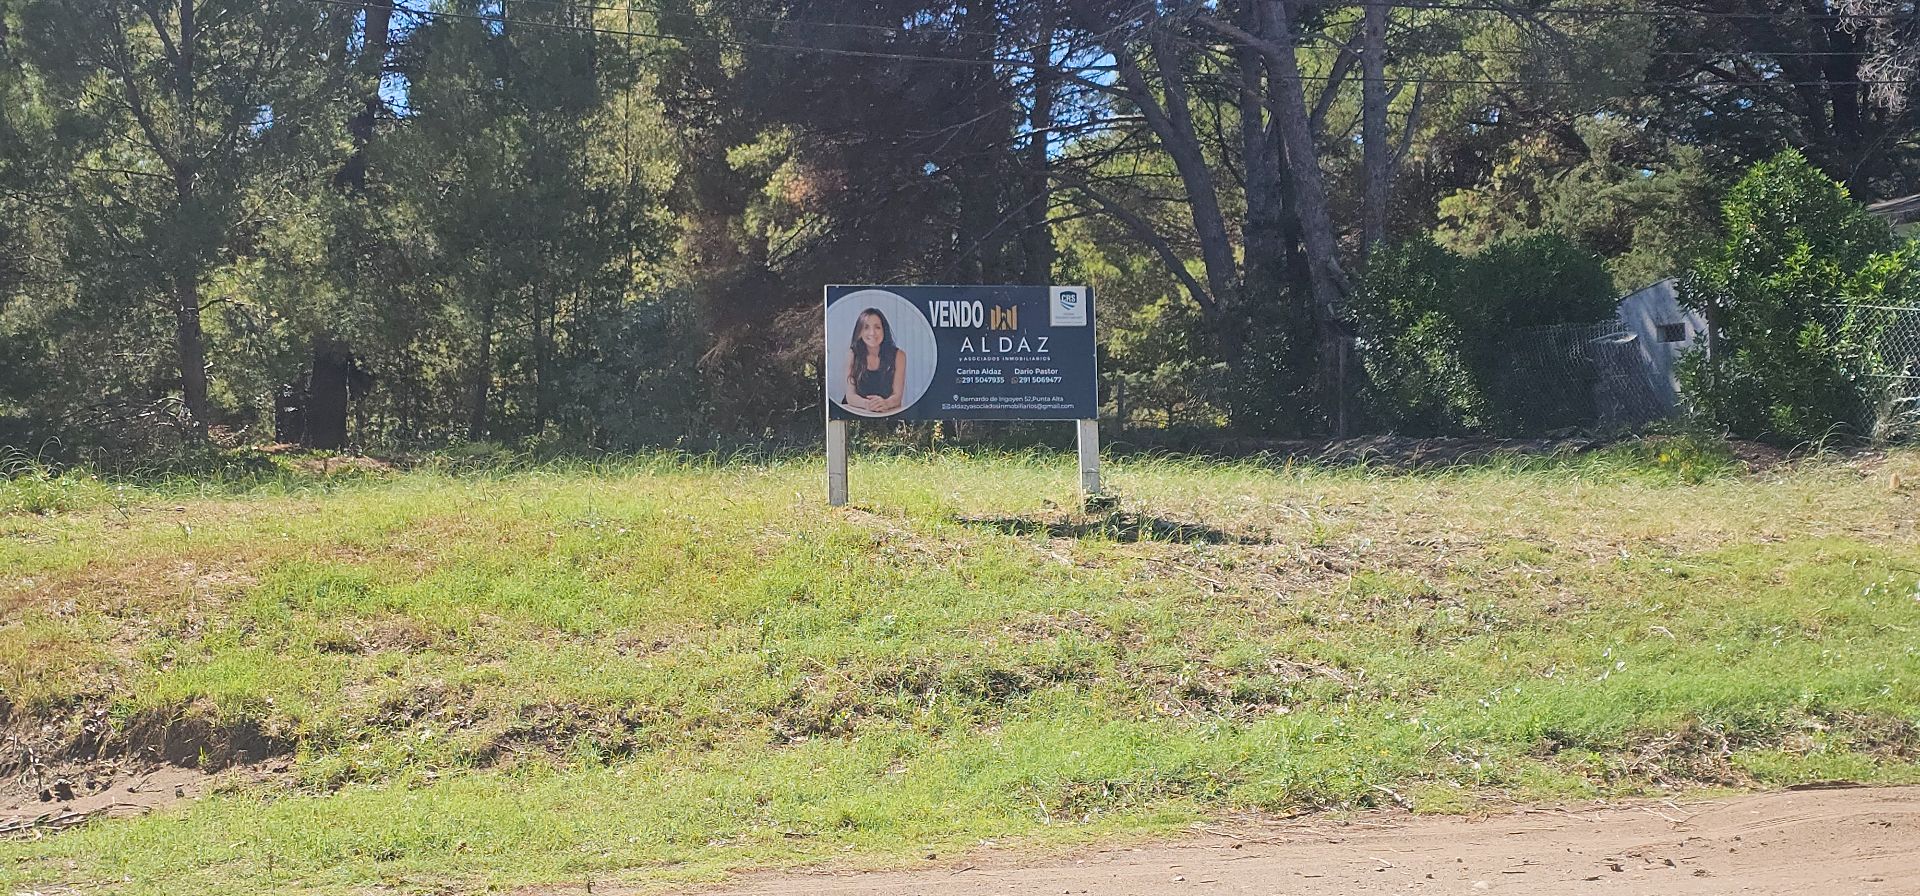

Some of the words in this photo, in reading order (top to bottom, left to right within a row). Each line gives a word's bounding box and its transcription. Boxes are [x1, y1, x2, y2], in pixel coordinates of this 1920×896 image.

[1062, 294, 1076, 302] CRS
[929, 300, 984, 328] VENDO
[961, 336, 1048, 352] ALDAZ
